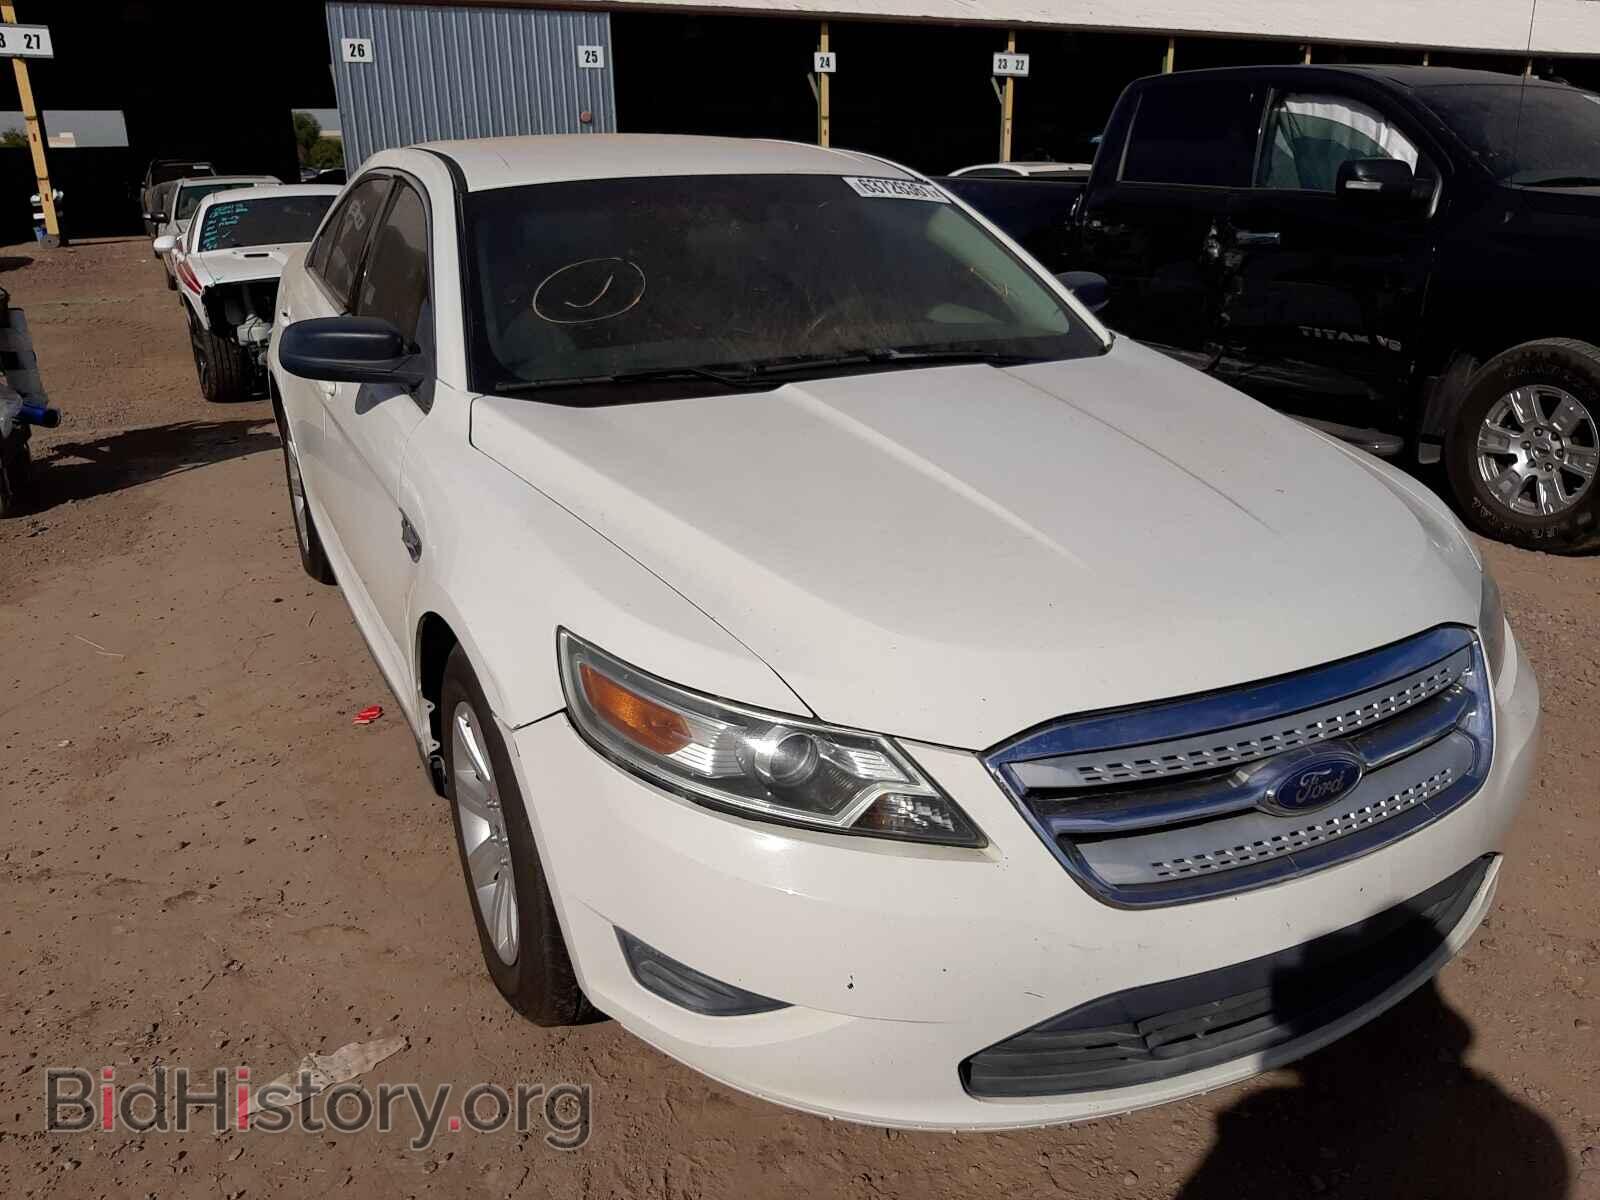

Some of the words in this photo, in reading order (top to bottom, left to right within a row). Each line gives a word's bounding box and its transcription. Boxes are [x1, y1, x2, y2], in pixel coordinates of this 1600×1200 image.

[23, 33, 41, 50] 27
[349, 43, 366, 58] 26
[584, 49, 598, 64] 25
[819, 56, 831, 69] 24
[998, 58, 1009, 70] 23
[1015, 59, 1026, 71] 22
[1297, 325, 1370, 342] TITAN
[1295, 767, 1345, 804] Ford
